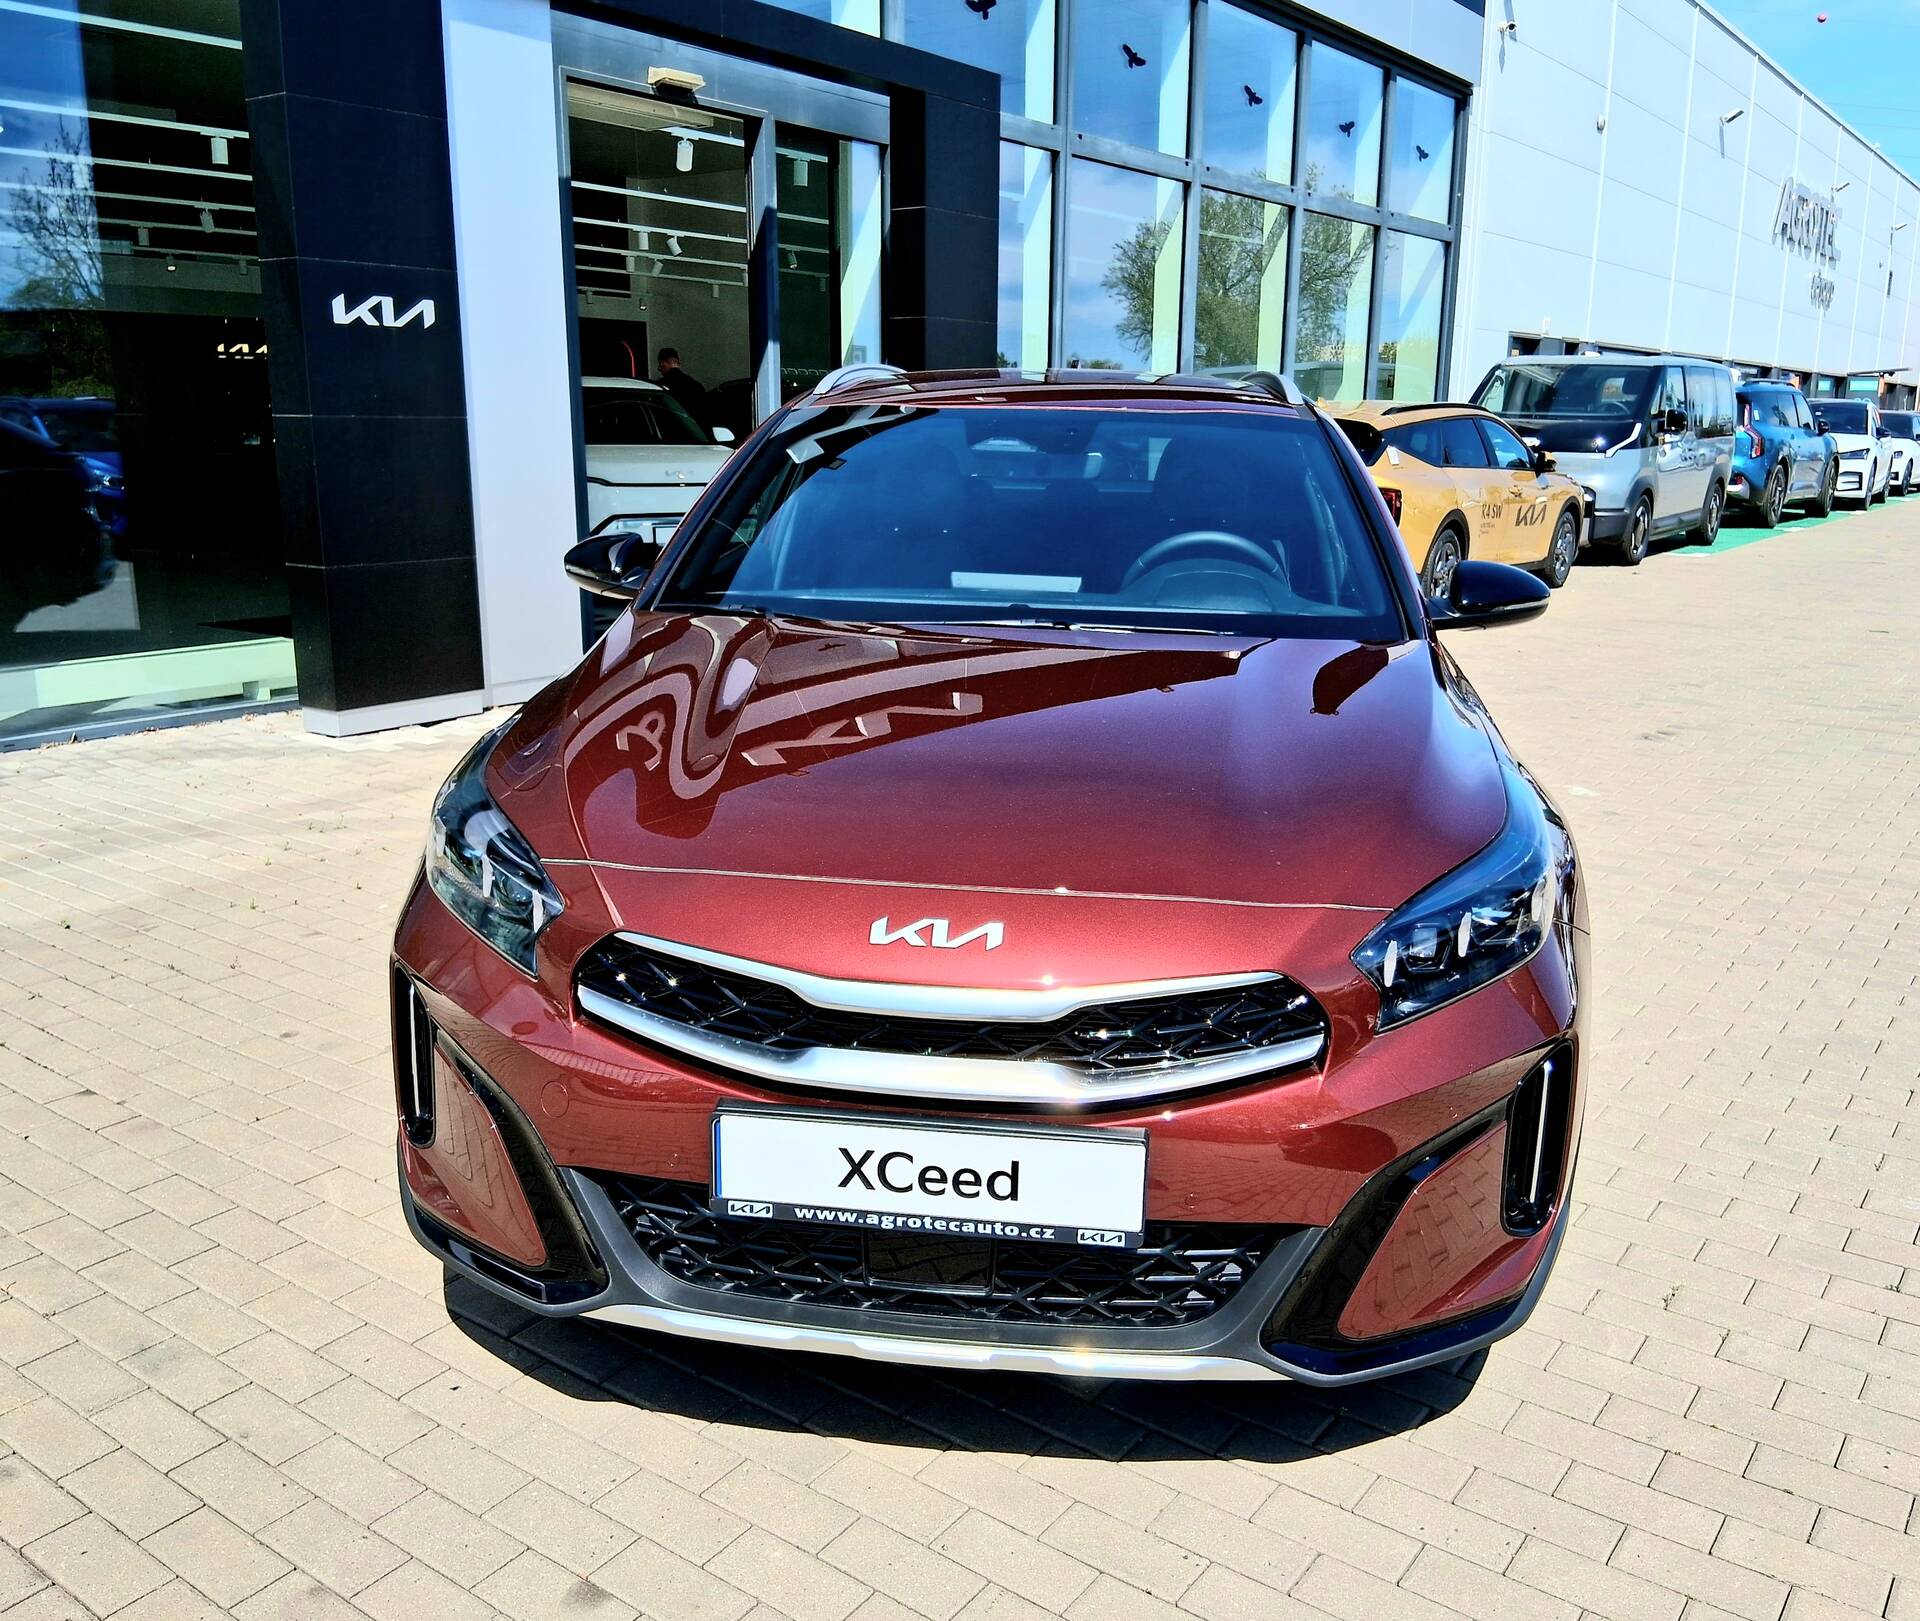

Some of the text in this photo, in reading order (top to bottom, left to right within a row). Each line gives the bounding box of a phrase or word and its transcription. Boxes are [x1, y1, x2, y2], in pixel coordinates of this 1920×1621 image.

[331, 293, 436, 330] KIA
[1514, 503, 1547, 527] KIA
[868, 915, 1005, 951] KIA
[837, 1146, 1020, 1202] XCeed
[730, 1203, 771, 1216] KIA
[793, 1206, 1056, 1240] www.agrotecauto.cz
[1079, 1231, 1123, 1244] KIA
